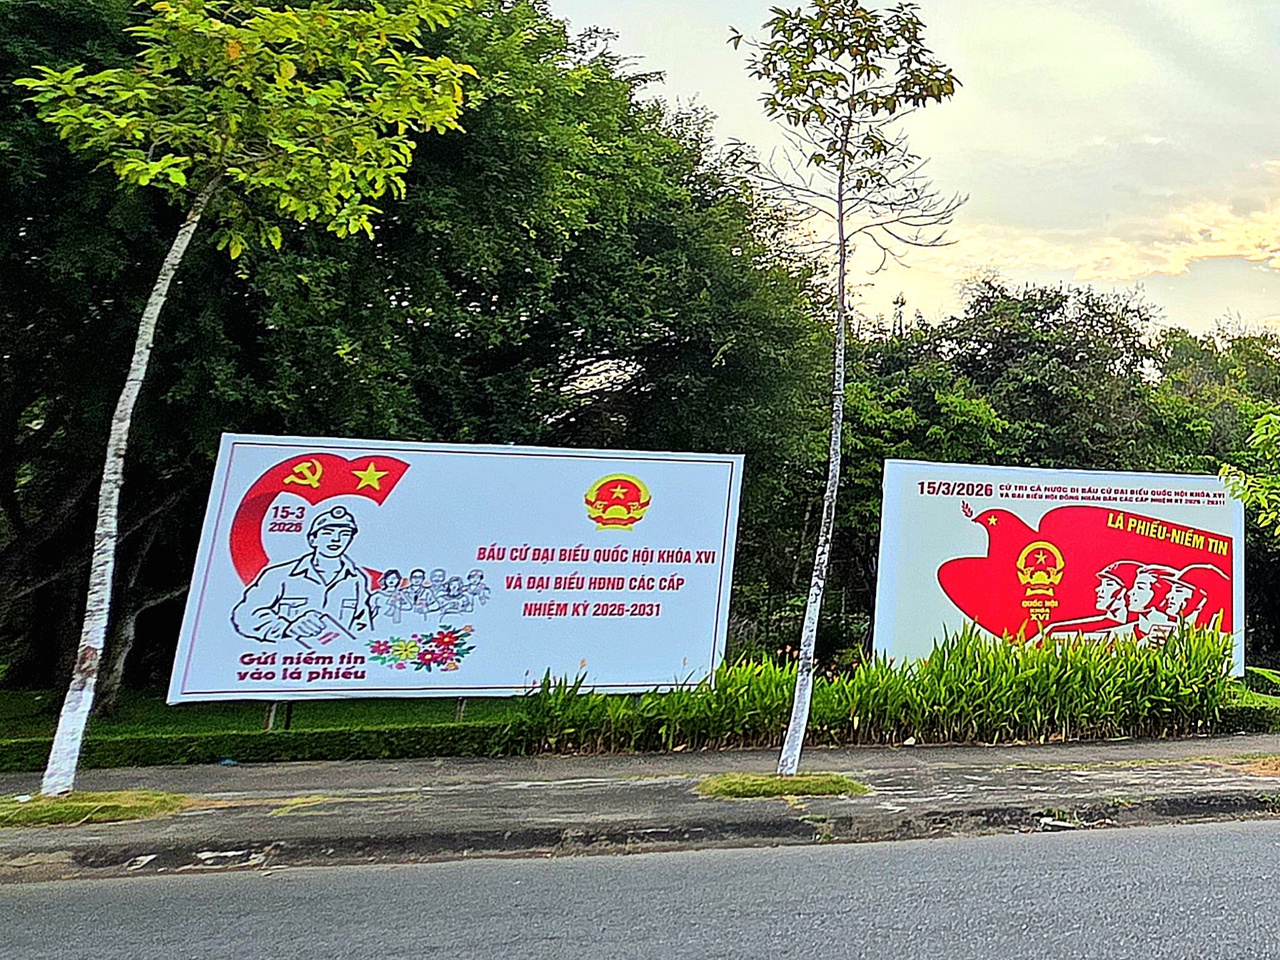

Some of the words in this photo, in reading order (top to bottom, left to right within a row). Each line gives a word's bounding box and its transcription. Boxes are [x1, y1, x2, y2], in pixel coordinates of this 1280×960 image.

[917, 481, 993, 497] 15/3/2026
[272, 506, 306, 519] 15-3
[268, 522, 303, 533] 2026
[1107, 512, 1124, 530] LÁ
[1207, 537, 1229, 556] TIN
[509, 543, 531, 562] CỬ
[531, 547, 556, 565] ĐẠI
[593, 544, 629, 564] QUỐC
[631, 547, 655, 566] HỘI
[657, 547, 692, 564] KHÓA
[695, 550, 717, 564] XVI
[526, 575, 550, 593] ĐẠI
[588, 576, 625, 591] HĐND
[628, 574, 655, 591] CÁC
[659, 572, 686, 591] CẤP
[522, 600, 568, 619] NHIỆM
[592, 603, 661, 617] 2026-2031
[1030, 613, 1050, 621] XVI
[339, 652, 366, 665] tin
[282, 667, 302, 680] lá
